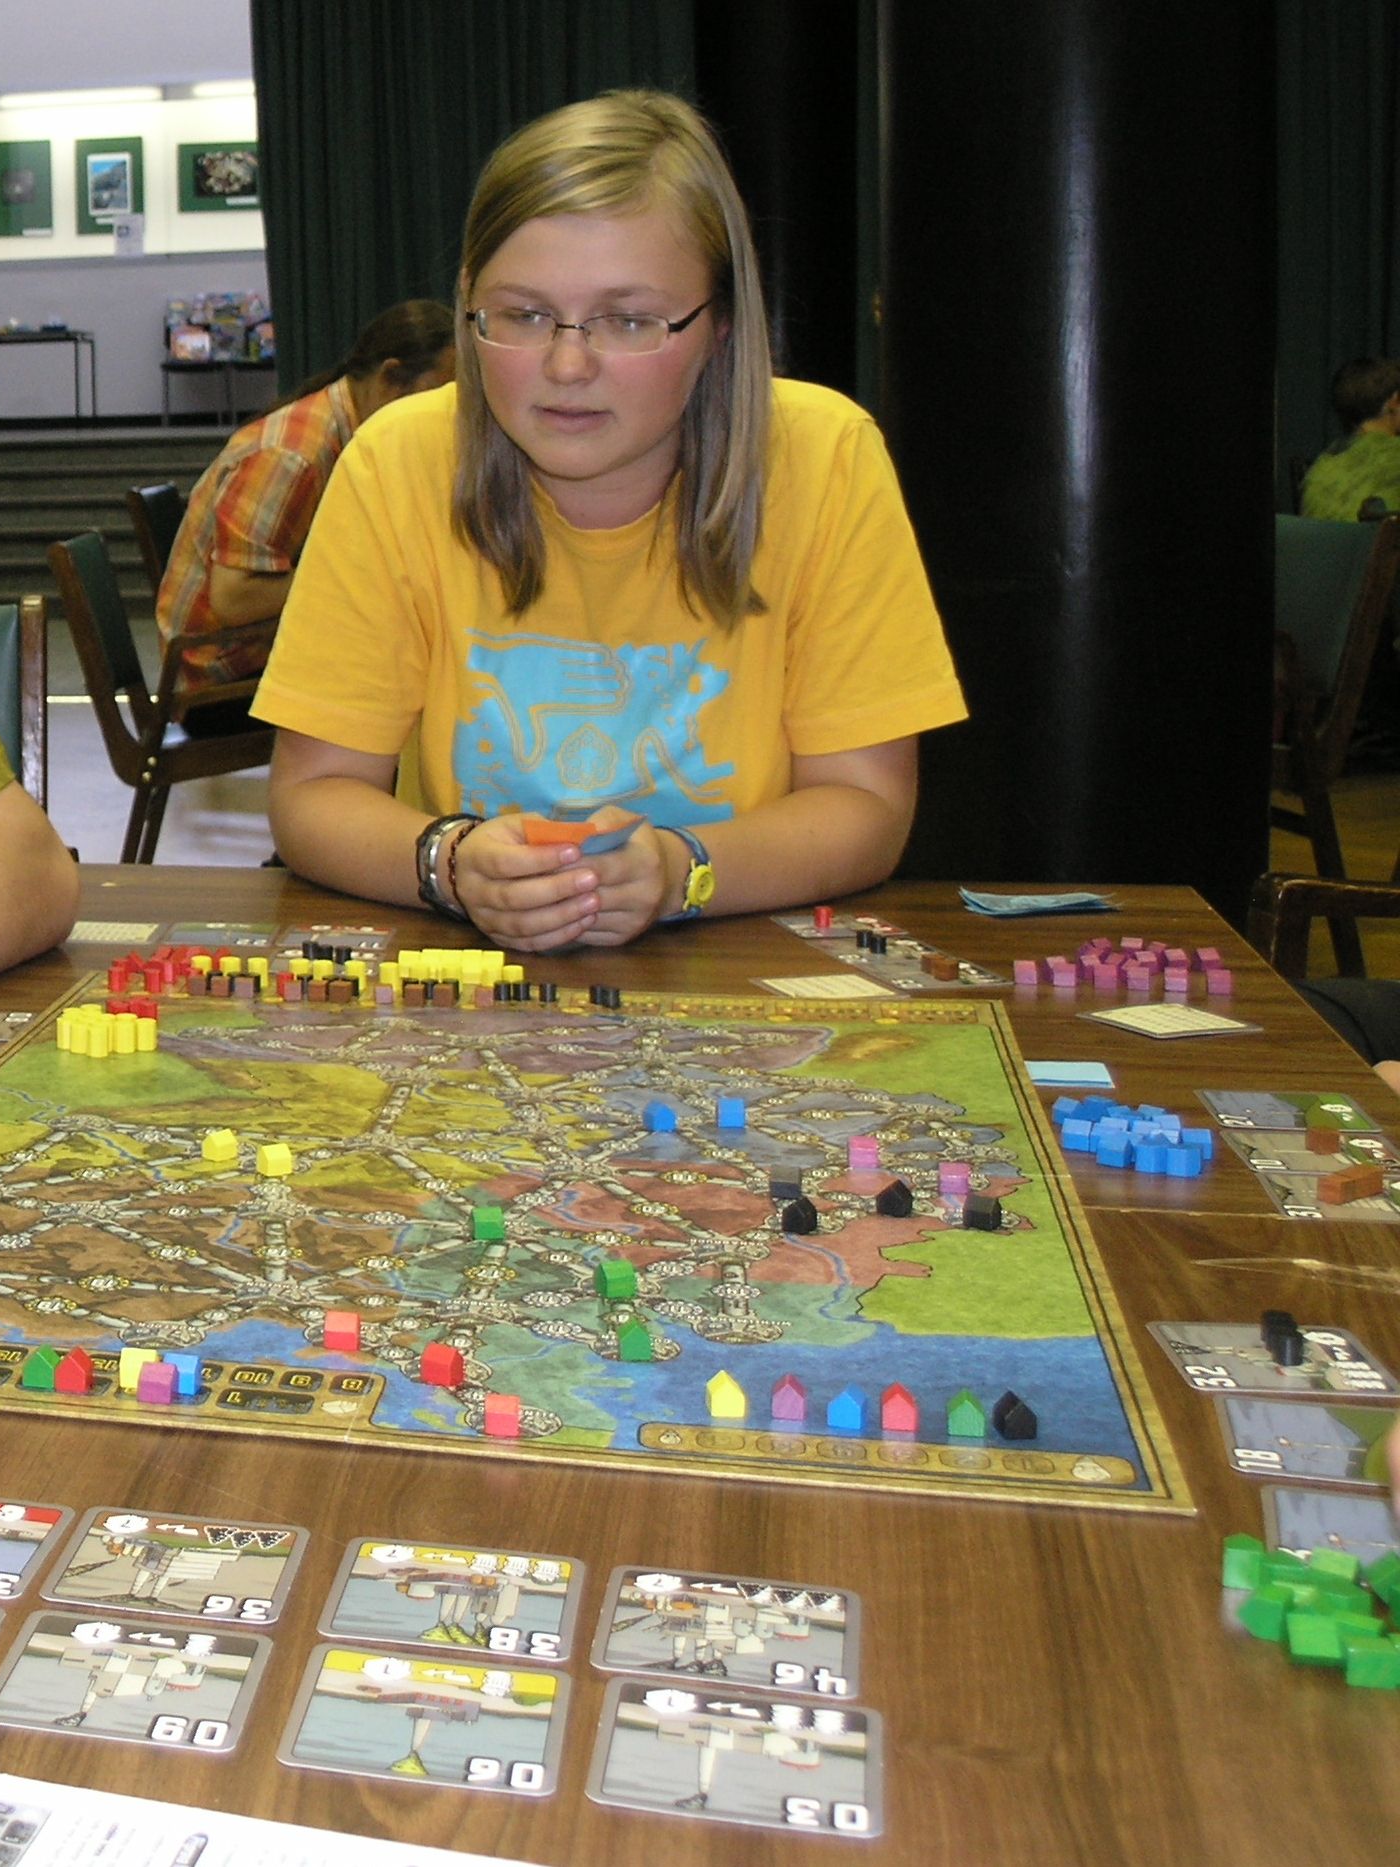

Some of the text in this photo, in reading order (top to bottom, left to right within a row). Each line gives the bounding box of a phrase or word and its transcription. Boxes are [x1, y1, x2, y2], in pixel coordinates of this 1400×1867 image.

[341, 1378, 363, 1391] 8
[1184, 1364, 1237, 1389] 32
[1232, 1447, 1284, 1470] 18
[200, 1594, 275, 1622] 36
[488, 1626, 563, 1659] 38
[772, 1661, 849, 1698] 46
[150, 1714, 230, 1747] 09
[465, 1755, 547, 1791] 06
[785, 1796, 870, 1832] 03
